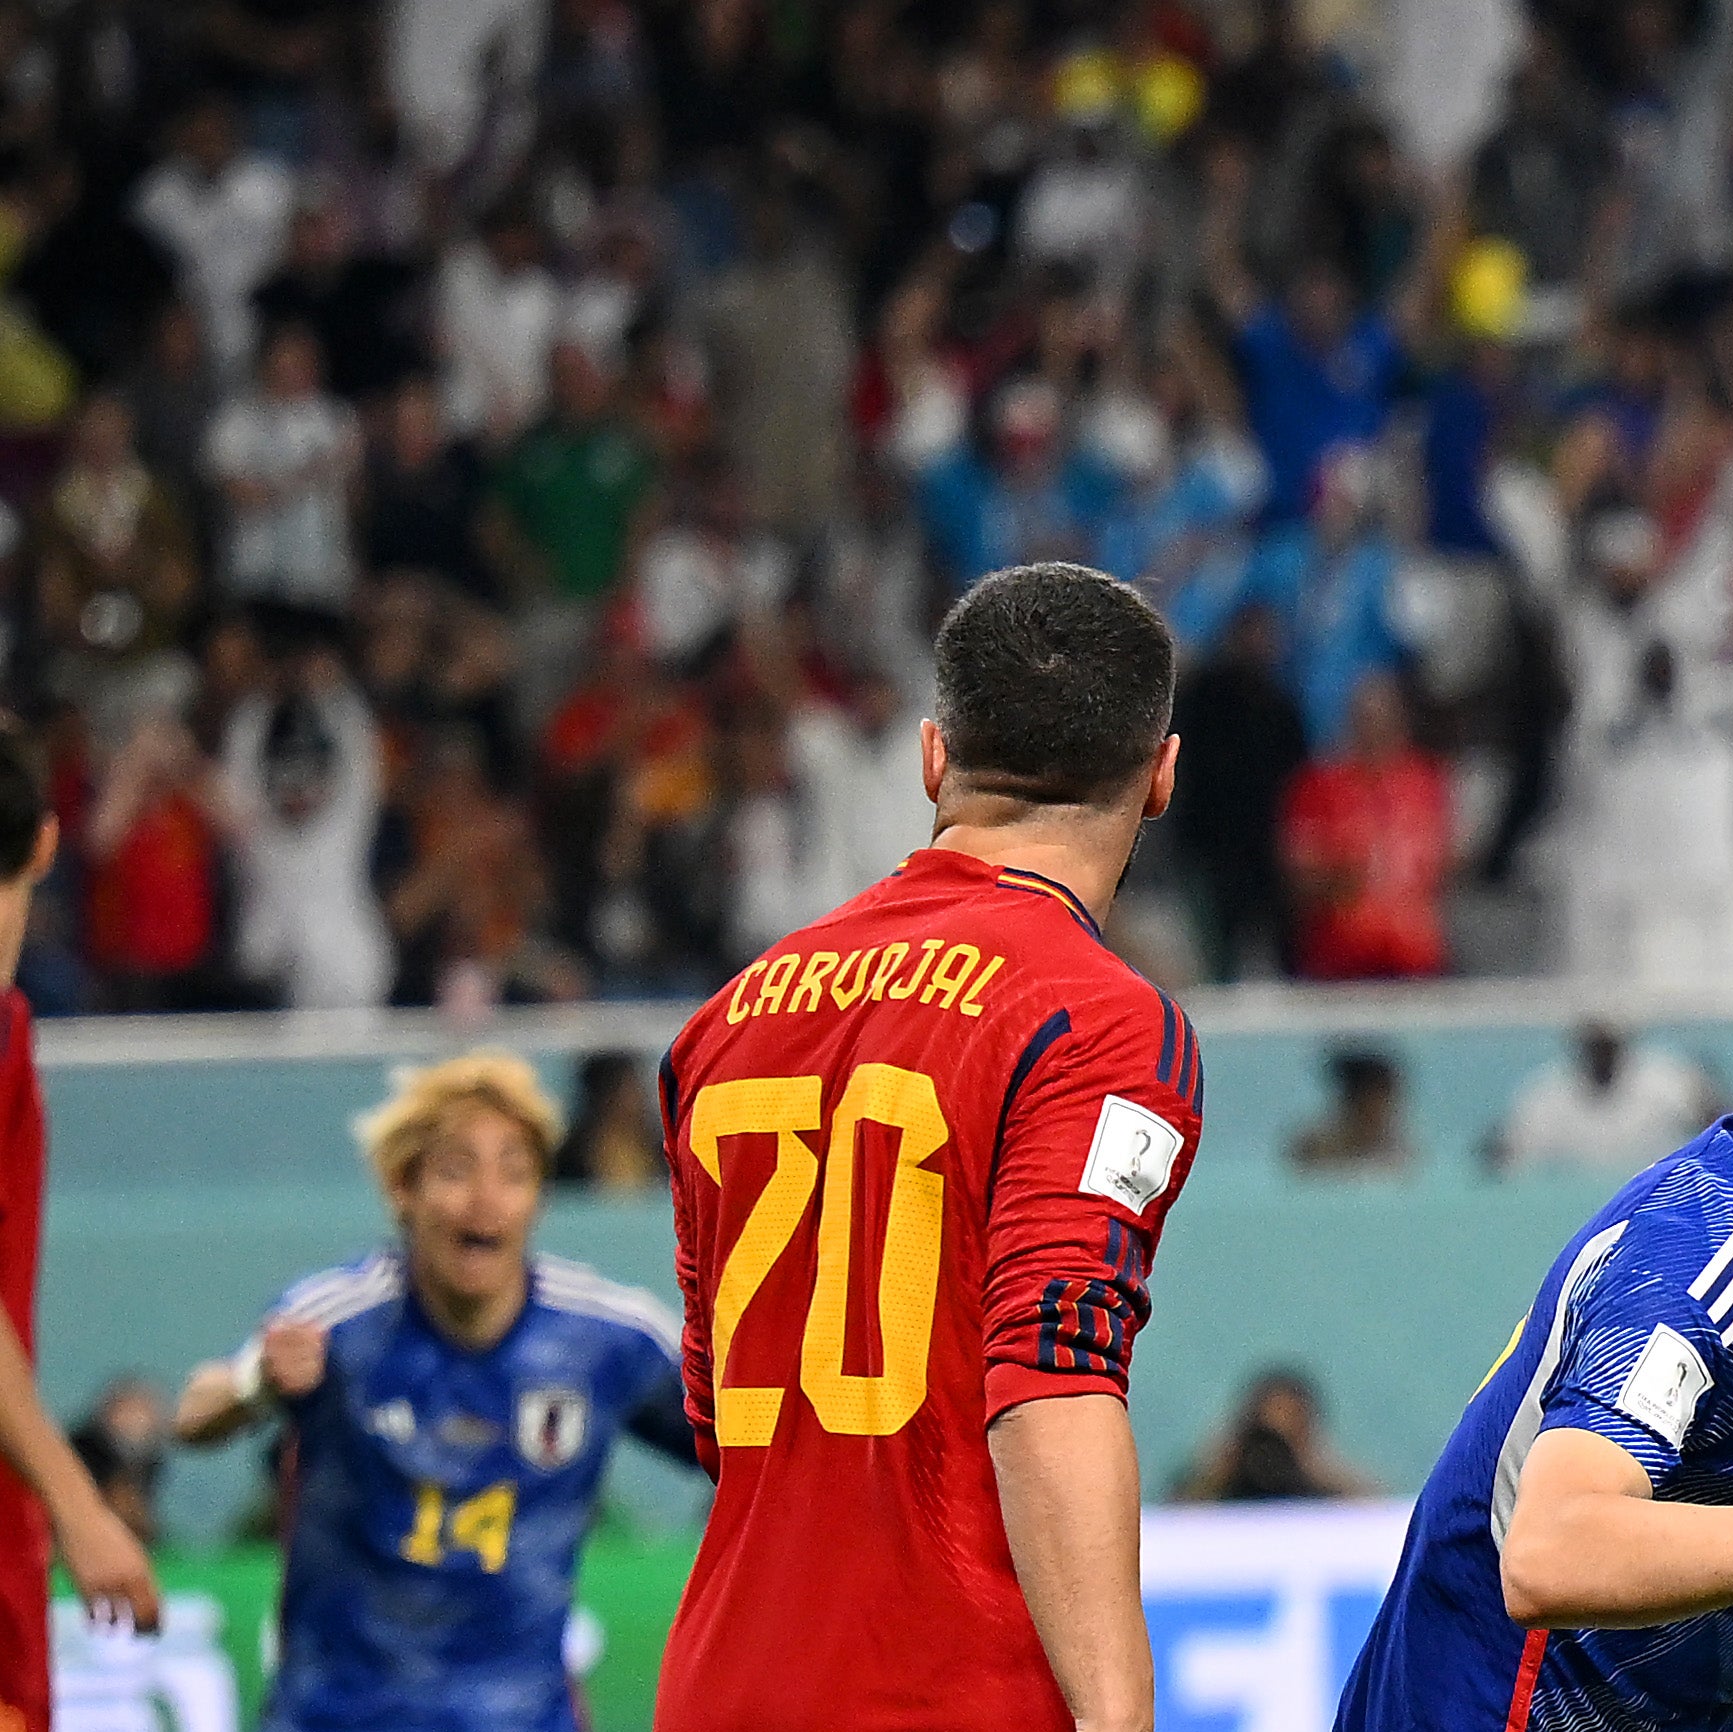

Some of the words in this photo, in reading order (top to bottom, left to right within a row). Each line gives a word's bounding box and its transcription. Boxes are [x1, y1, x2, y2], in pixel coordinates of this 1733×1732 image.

[726, 939, 1006, 1025] CARVAJAL
[689, 1062, 949, 1447] 20
[400, 1482, 517, 1574] 14
